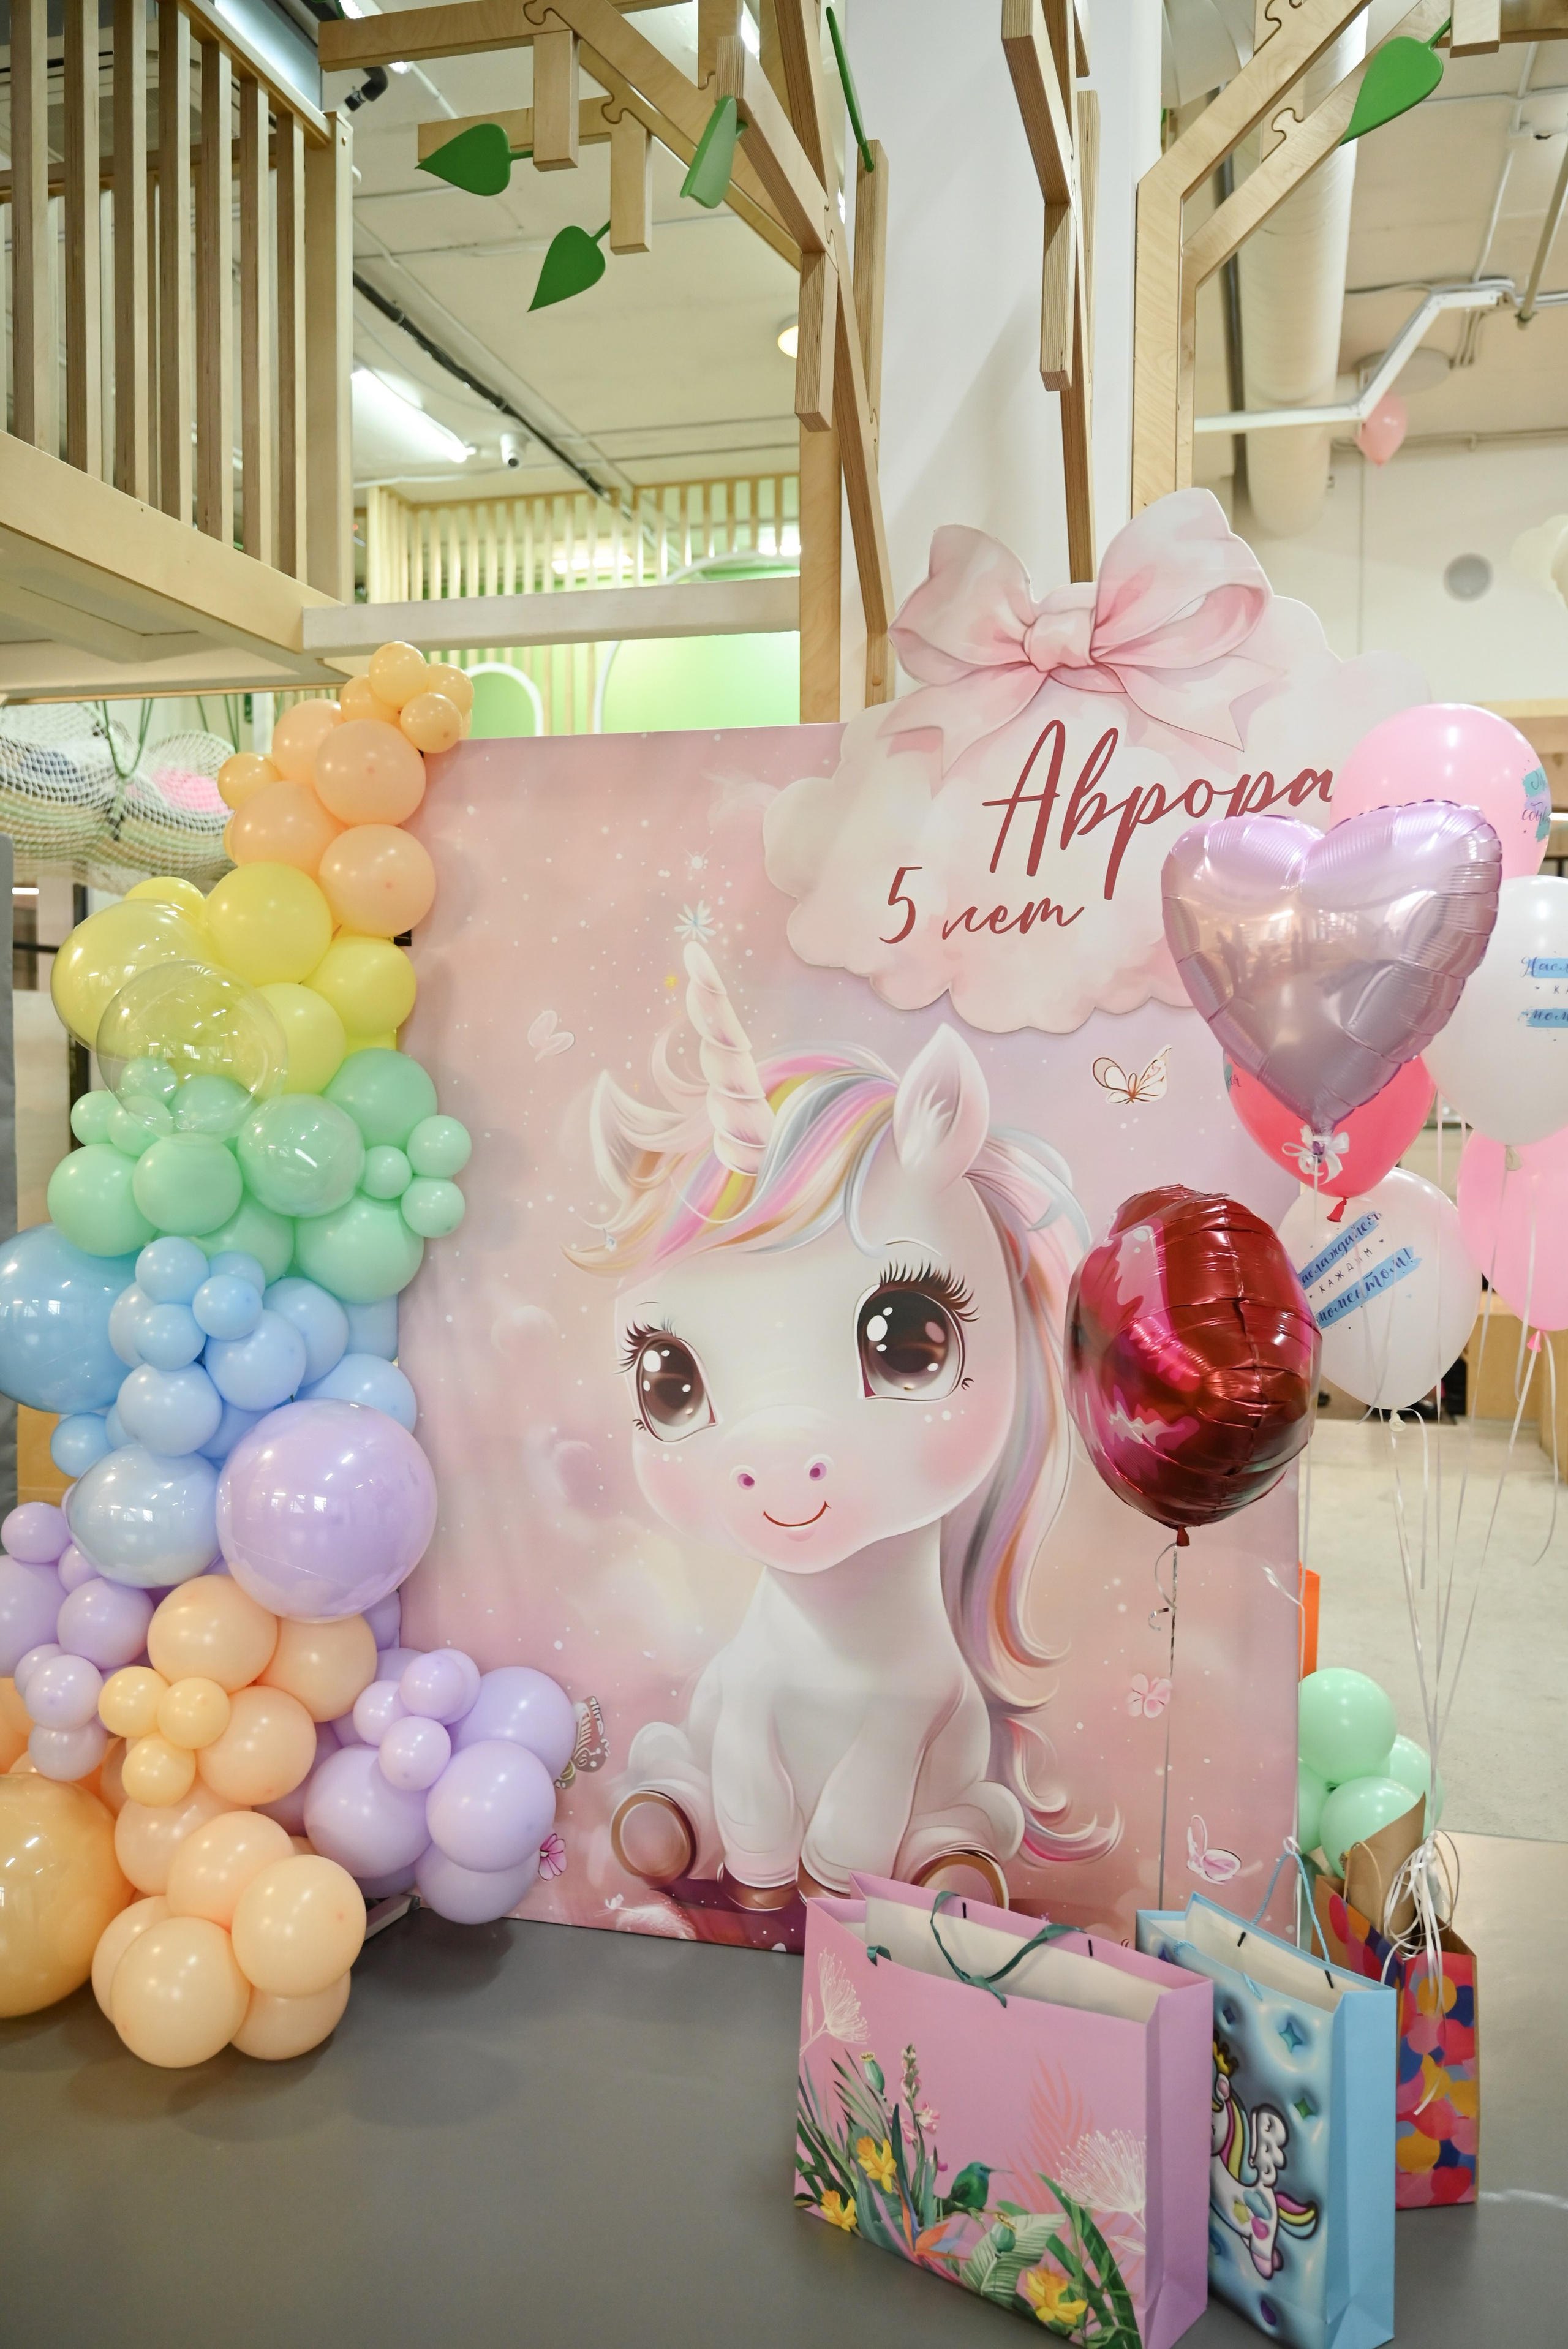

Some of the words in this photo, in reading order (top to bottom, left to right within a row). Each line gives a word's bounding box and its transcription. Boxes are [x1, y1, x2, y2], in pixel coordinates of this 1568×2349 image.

[982, 720, 1333, 900] Аврора
[878, 866, 923, 944] 5
[942, 897, 1085, 940] лет
[1300, 1212, 1382, 1284] аслаждайся
[1316, 1247, 1414, 1324] моментом!
